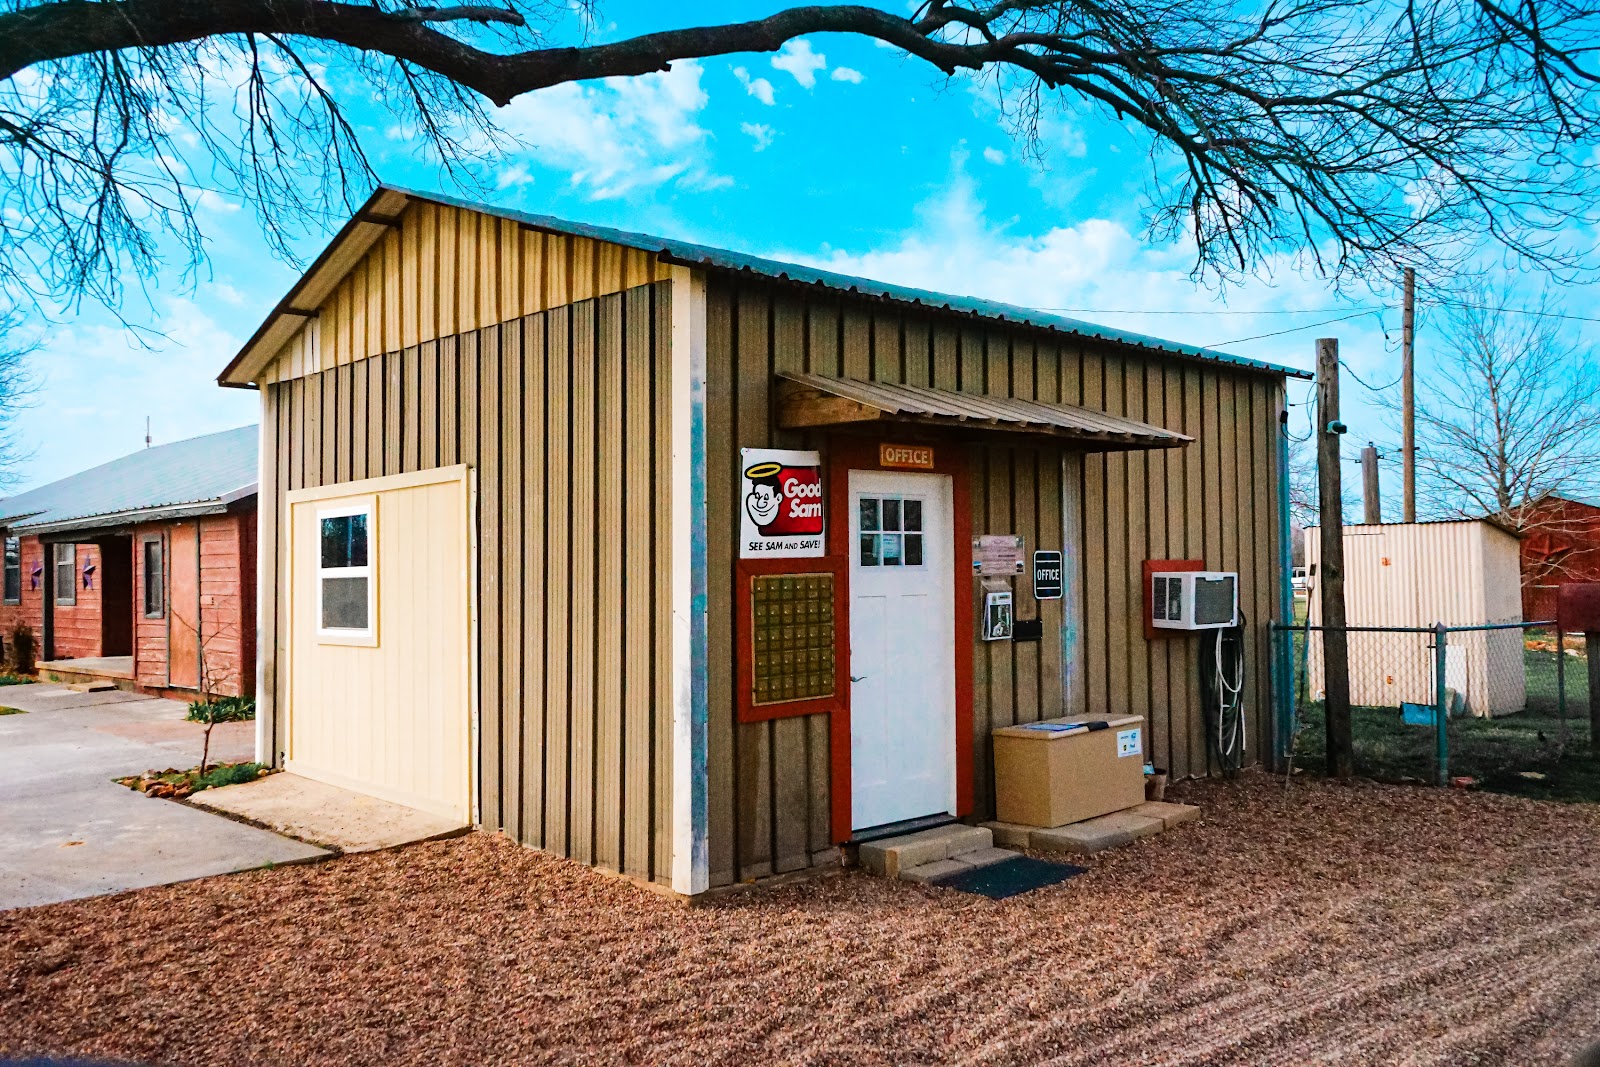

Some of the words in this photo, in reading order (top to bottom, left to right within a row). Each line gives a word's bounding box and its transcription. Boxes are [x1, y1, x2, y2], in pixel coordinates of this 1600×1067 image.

[885, 448, 929, 464] OFFICE
[783, 477, 822, 498] Good
[788, 498, 822, 518] Sam
[748, 541, 763, 551] SEE
[765, 541, 783, 551] SAM
[784, 542, 799, 550] AND
[800, 540, 821, 549] SAVE!
[1036, 569, 1060, 581] OFFICE
